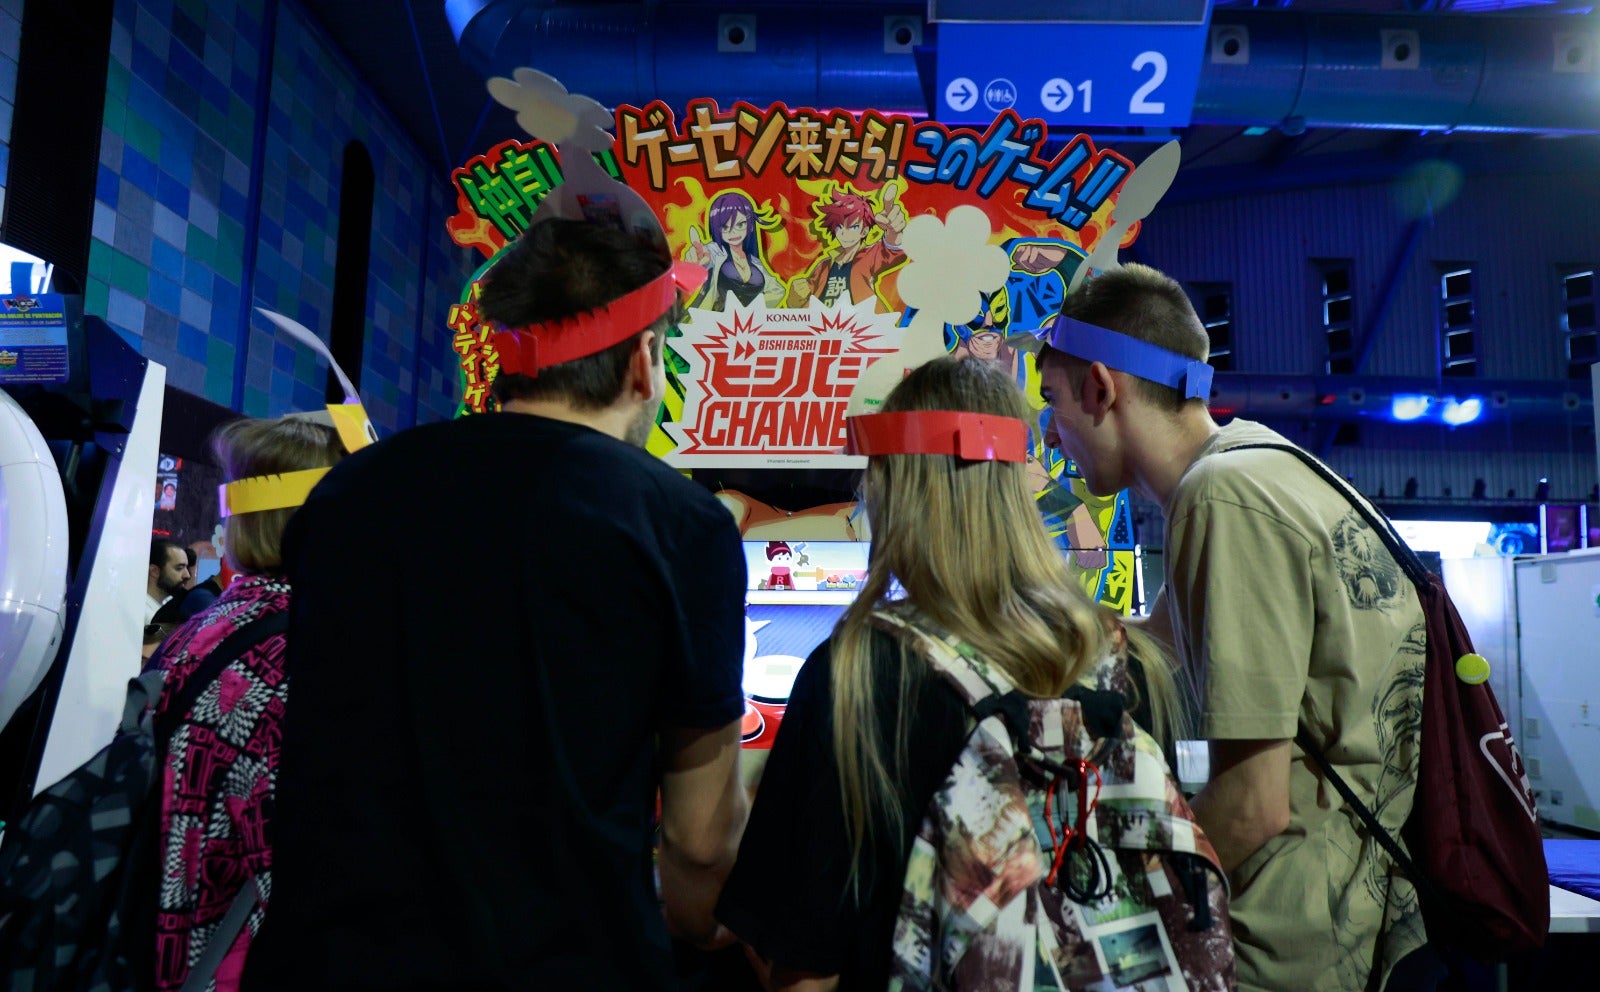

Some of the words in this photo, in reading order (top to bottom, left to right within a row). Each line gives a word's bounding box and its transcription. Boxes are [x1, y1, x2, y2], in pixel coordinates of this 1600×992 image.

[1076, 79, 1093, 114] 1
[1128, 50, 1168, 115] 2
[765, 313, 811, 323] KONAMI
[701, 401, 848, 447] CHANNE
